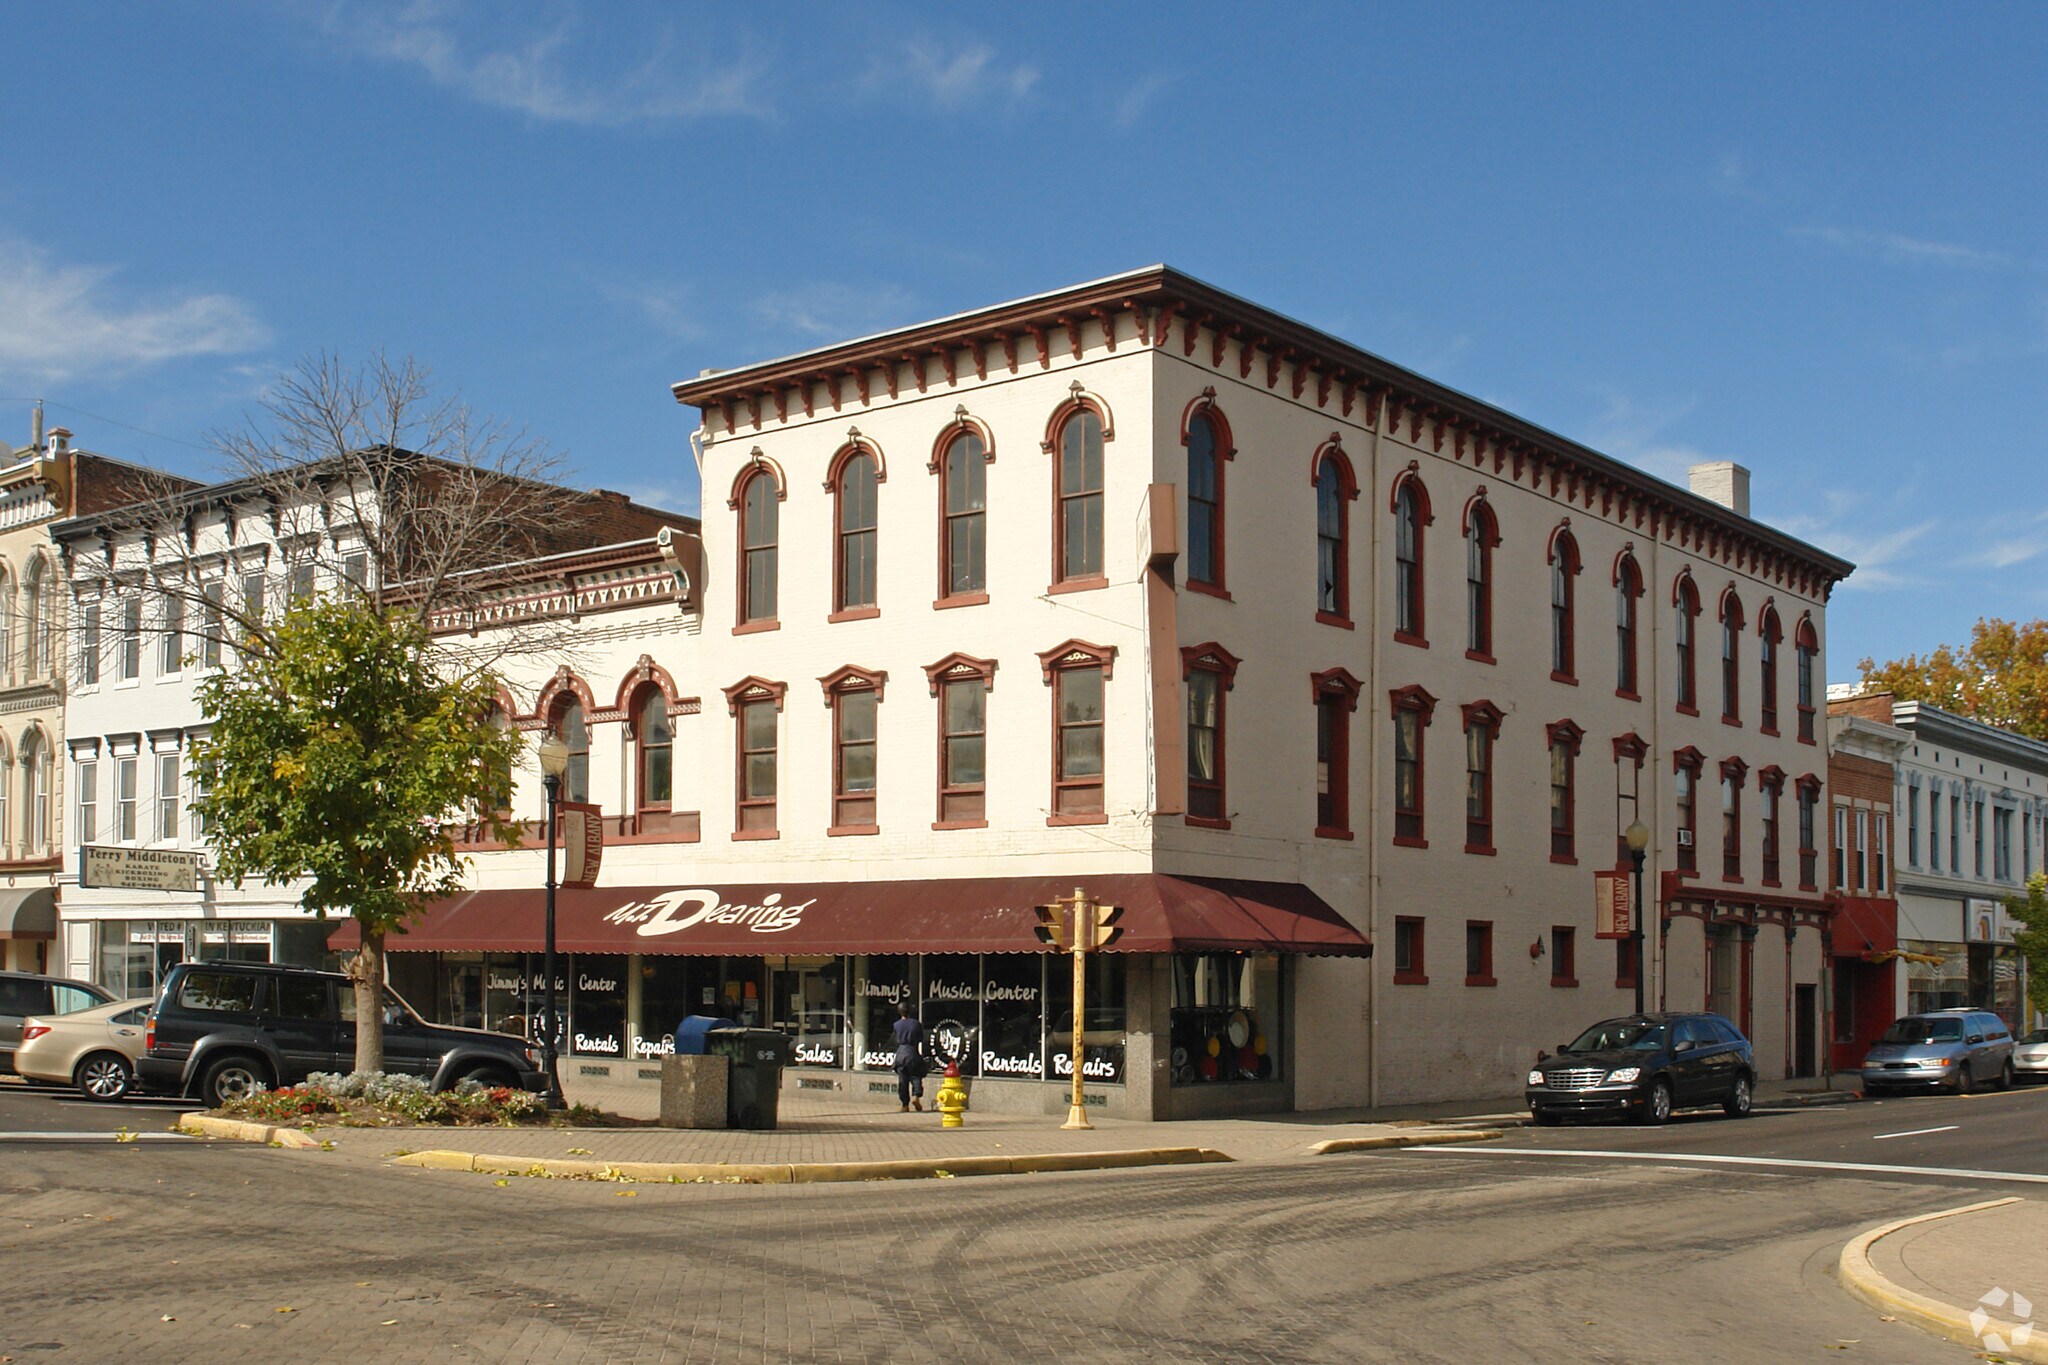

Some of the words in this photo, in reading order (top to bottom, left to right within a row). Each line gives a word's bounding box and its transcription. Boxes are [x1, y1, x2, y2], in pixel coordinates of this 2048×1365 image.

[585, 811, 602, 856] ALBANY
[88, 848, 122, 862] Terry
[127, 850, 195, 865] Middleton's
[125, 863, 160, 871] KARATE
[115, 869, 169, 877] KICKBOXING
[582, 858, 600, 882] NEW
[1614, 877, 1629, 911] ALBANY
[636, 889, 818, 937] Dearing
[1614, 912, 1629, 933] NEW
[147, 921, 175, 931] VTED
[205, 922, 215, 931] IN
[487, 973, 527, 996] Jimmy's
[533, 973, 565, 991] Muic
[579, 973, 618, 991] Center
[855, 978, 911, 1004] Jimmy's
[929, 979, 973, 999] Music
[985, 980, 1039, 1000] Center
[575, 1033, 619, 1053] Rentals
[632, 1036, 676, 1060] Repairs
[794, 1042, 835, 1063] Sales
[857, 1045, 897, 1066] Lesso
[982, 1050, 1043, 1073] Rentals
[1052, 1053, 1116, 1077] Reairs
